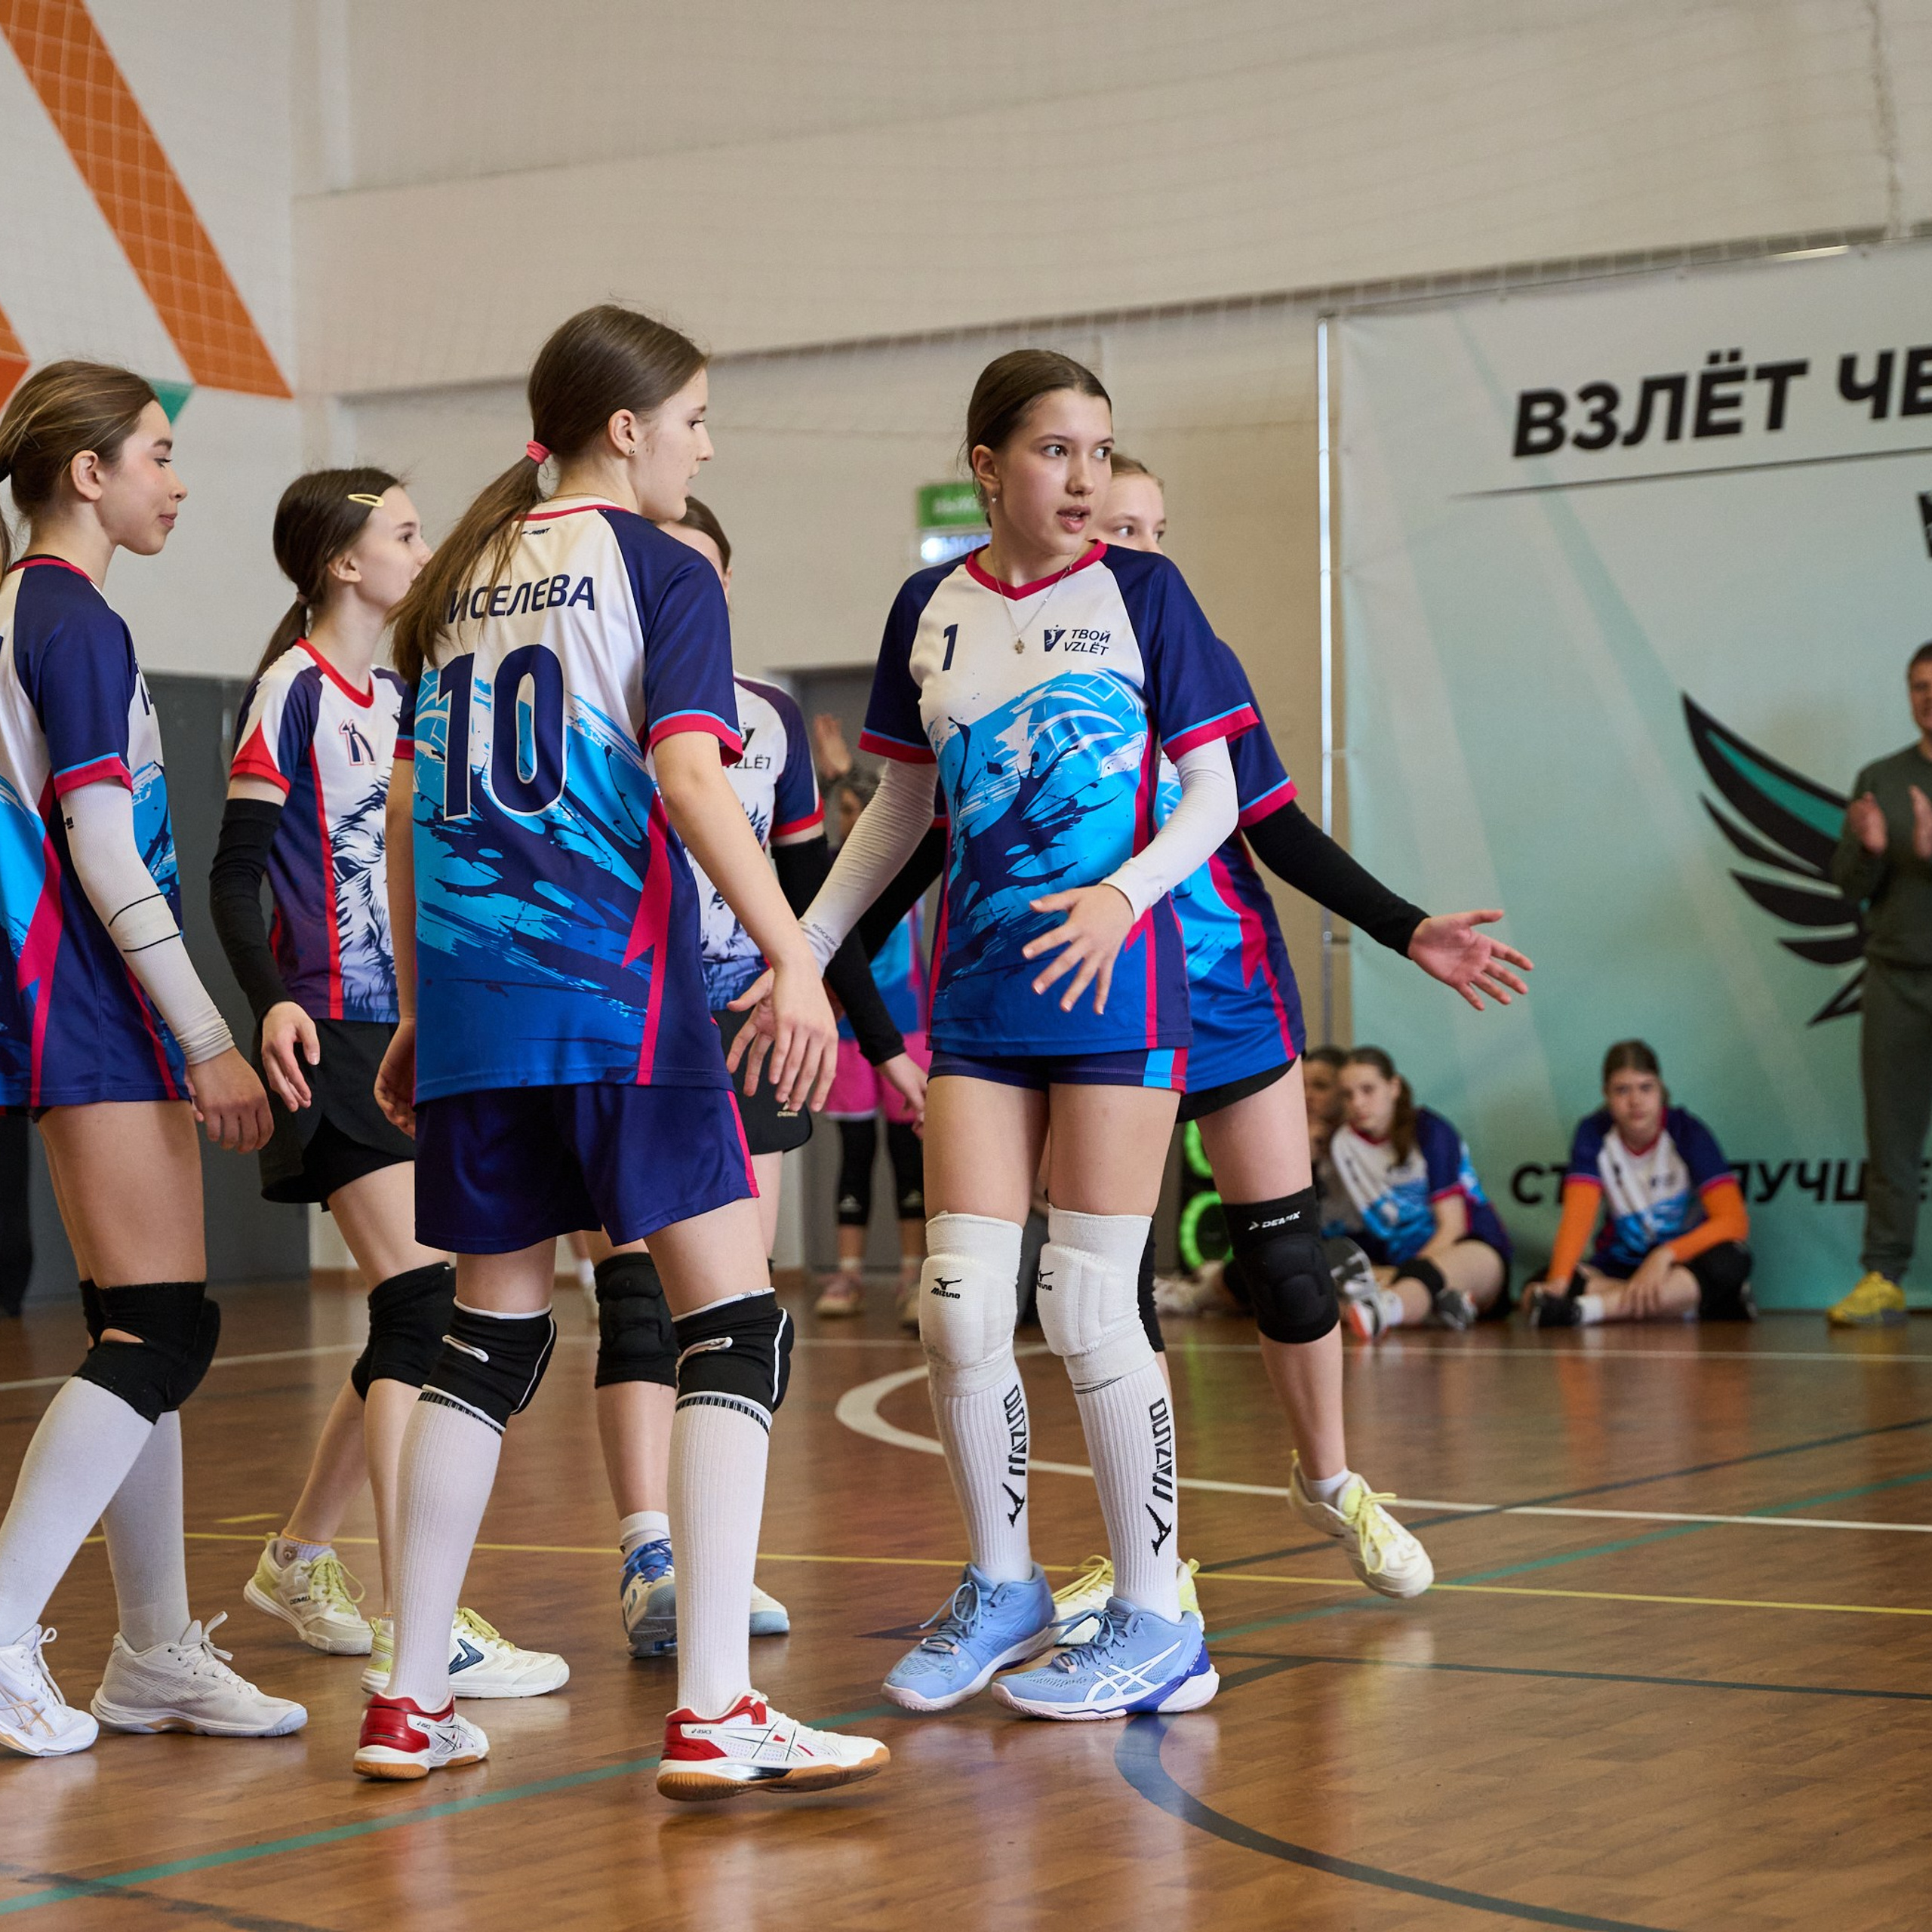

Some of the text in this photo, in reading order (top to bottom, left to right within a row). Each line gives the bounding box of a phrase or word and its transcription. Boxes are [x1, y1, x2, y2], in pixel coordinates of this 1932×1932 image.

[1513, 348, 1809, 457] ВЗЛЁТ
[448, 574, 595, 624] ИСЕЛЕВА
[942, 623, 958, 671] 1
[1064, 641, 1109, 656] VZLËT
[1072, 629, 1111, 643] ТВОЙ
[436, 644, 566, 820] 10
[727, 754, 771, 769] ZLËT
[1728, 1161, 1930, 1204] УЧШ
[1262, 1211, 1300, 1229] DEMIX
